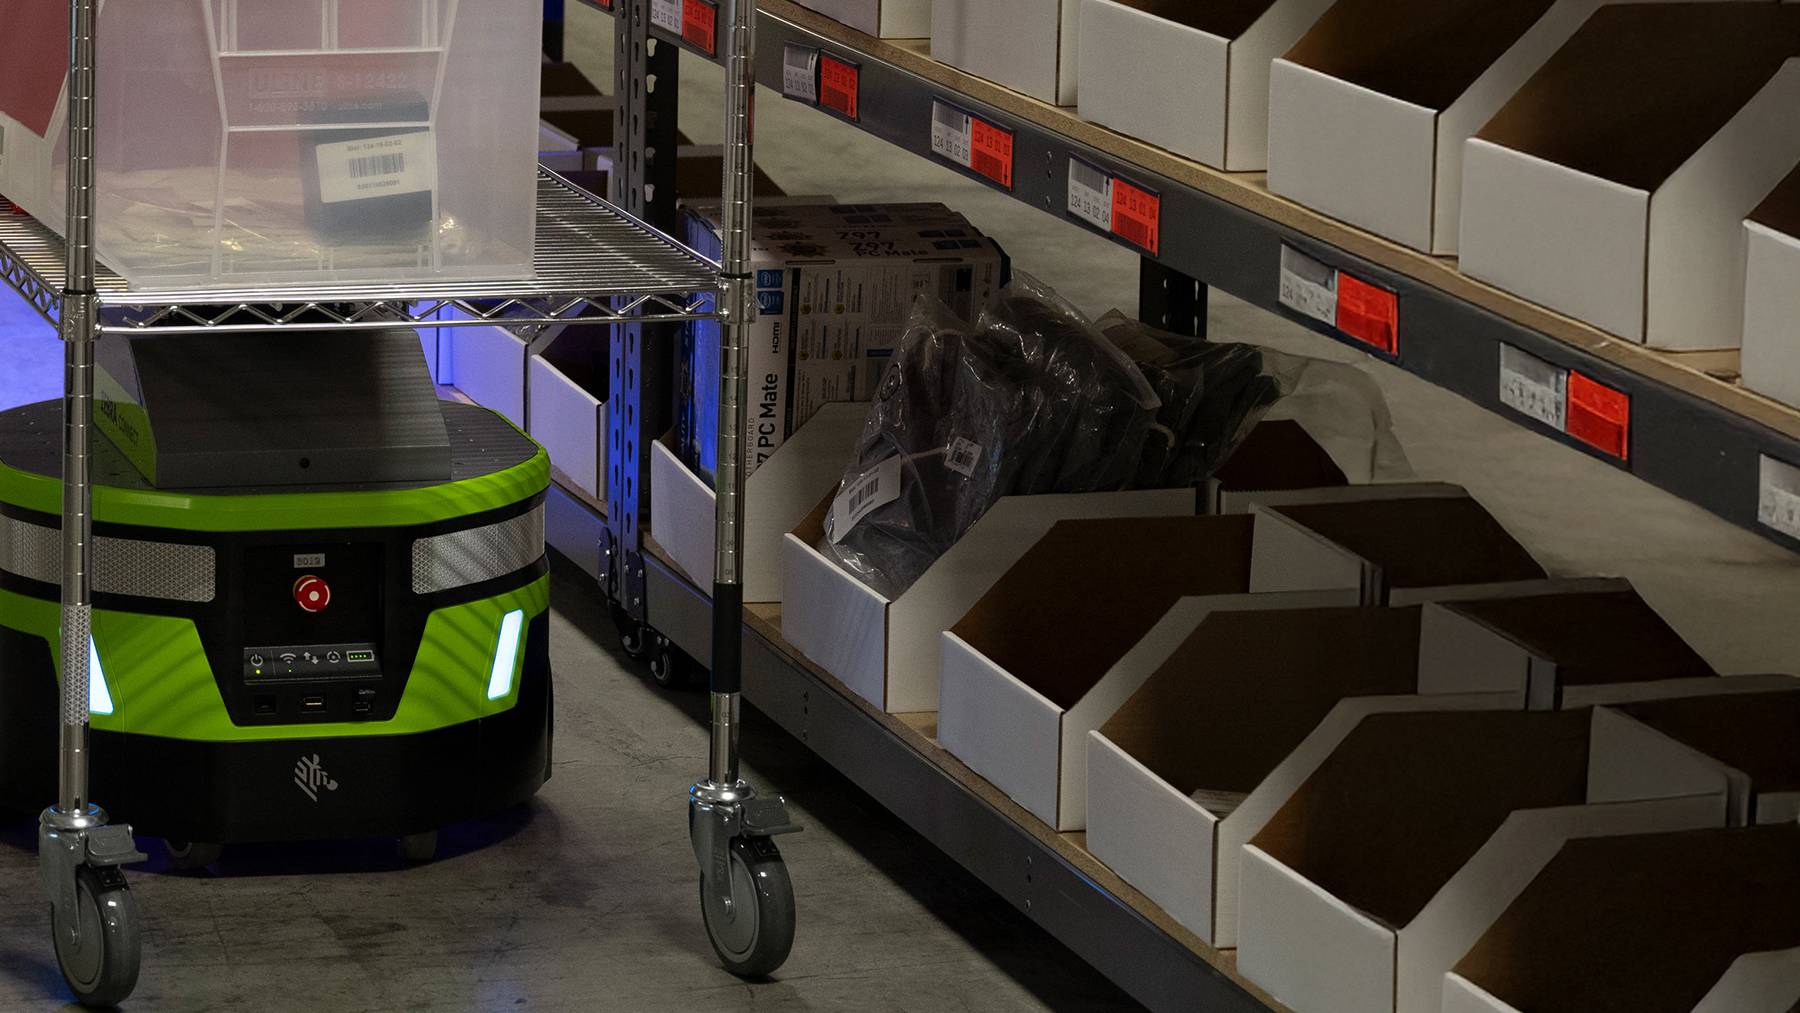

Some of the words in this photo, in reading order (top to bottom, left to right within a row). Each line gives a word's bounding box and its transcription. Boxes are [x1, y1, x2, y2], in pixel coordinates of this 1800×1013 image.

[651, 8, 660, 20] 124
[660, 12, 667, 24] 13
[785, 77, 793, 90] 124
[794, 79, 800, 92] 13
[824, 67, 833, 80] 124
[833, 71, 840, 84] 13
[934, 134, 944, 148] 124
[946, 140, 953, 154] 13
[953, 143, 961, 157] 02
[961, 147, 969, 161] 03
[974, 130, 984, 145] 124
[986, 135, 993, 149] 13
[994, 139, 1001, 154] 01
[1003, 143, 1010, 157] 03
[1070, 193, 1081, 209] 124
[1083, 199, 1091, 215] 13
[1092, 204, 1100, 220] 02
[1101, 209, 1110, 224] 04
[1116, 191, 1127, 206] 124
[1129, 197, 1137, 212] 13
[1139, 201, 1146, 217] 01
[1148, 206, 1156, 220] 04
[837, 231, 881, 240] Z97
[849, 241, 894, 251] Z97
[855, 249, 881, 257] PC
[882, 248, 928, 257] Mate
[759, 373, 778, 418] Mate
[100, 389, 118, 426] ZEBRA
[118, 415, 139, 445] CONNECT
[745, 417, 755, 478] OTHERBOARD
[757, 422, 776, 448] PC
